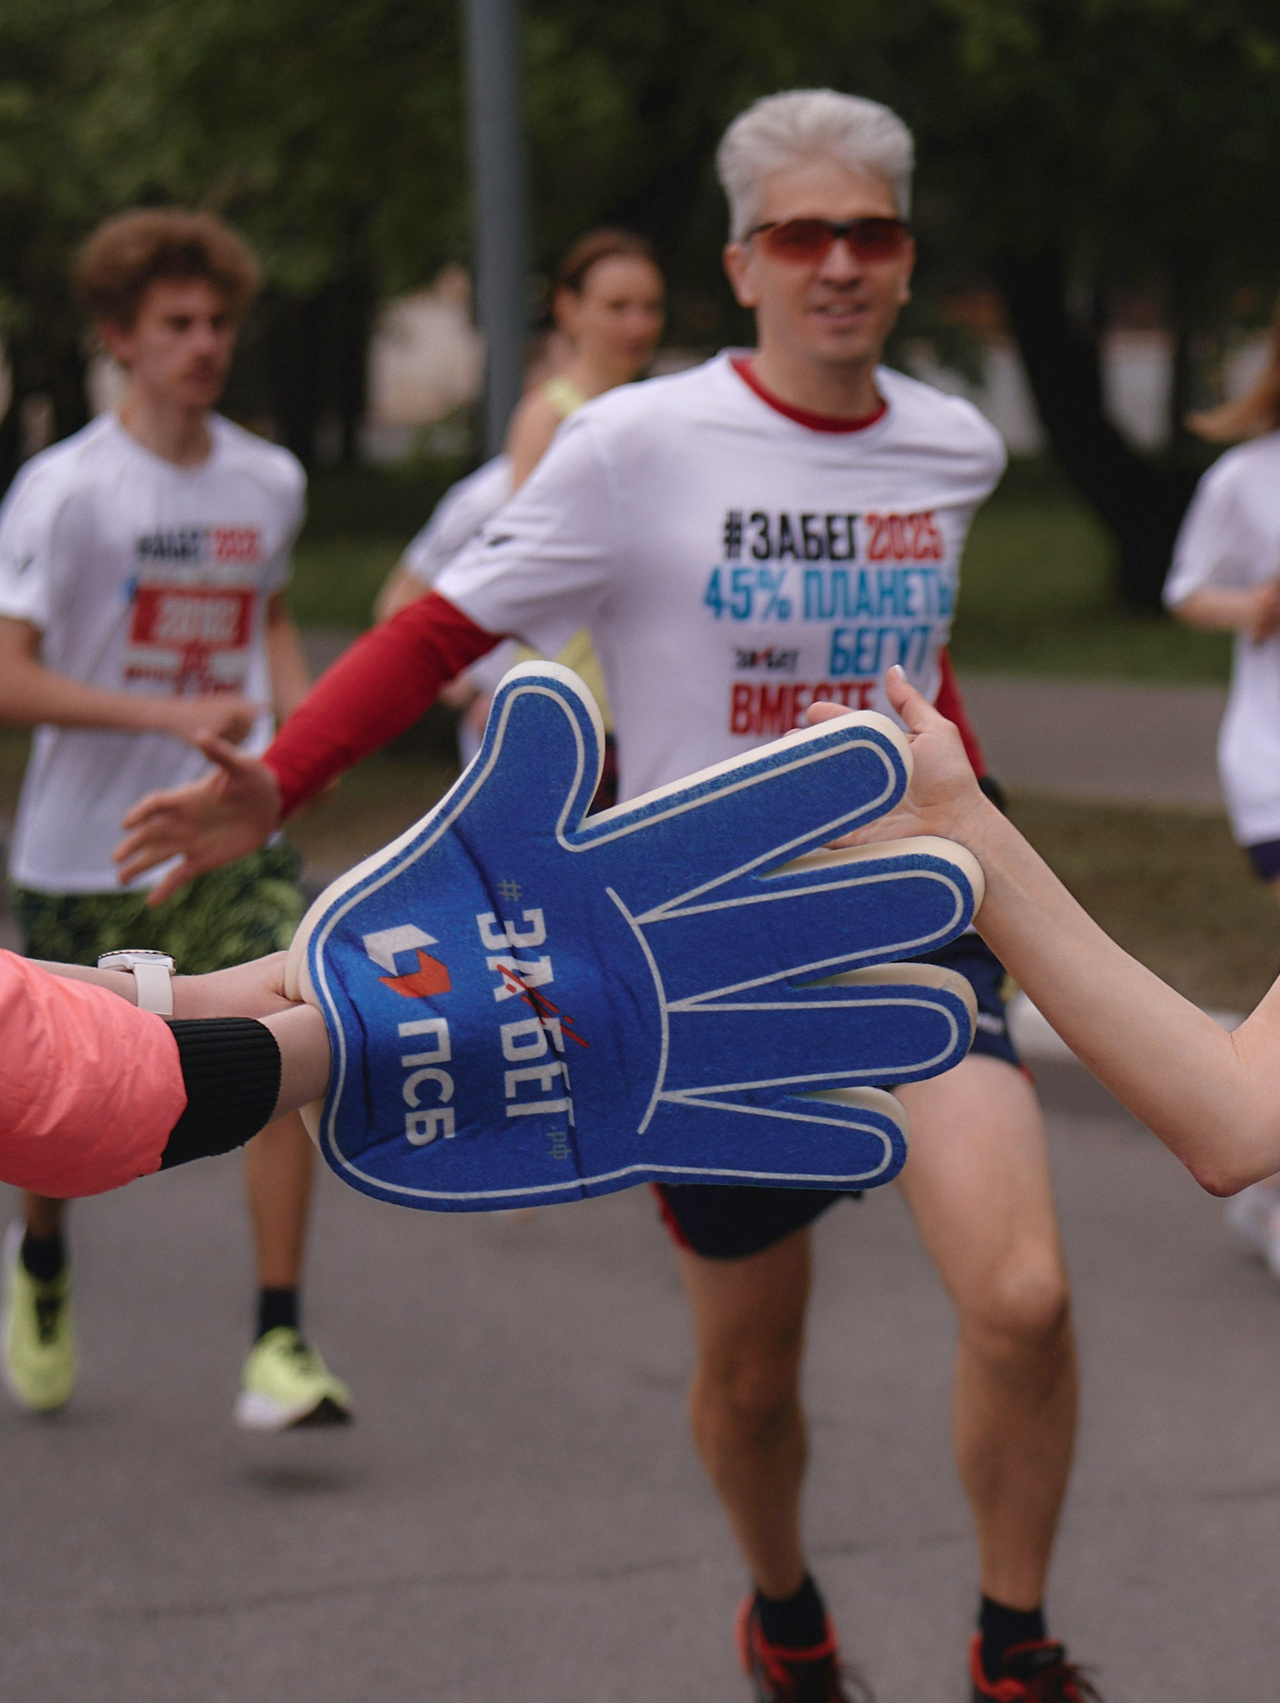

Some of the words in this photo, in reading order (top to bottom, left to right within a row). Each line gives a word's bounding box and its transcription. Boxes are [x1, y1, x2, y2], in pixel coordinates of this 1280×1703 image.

[703, 566, 792, 620] 45%
[829, 625, 933, 676] БЕГУТ
[398, 1017, 455, 1146] ПСБ
